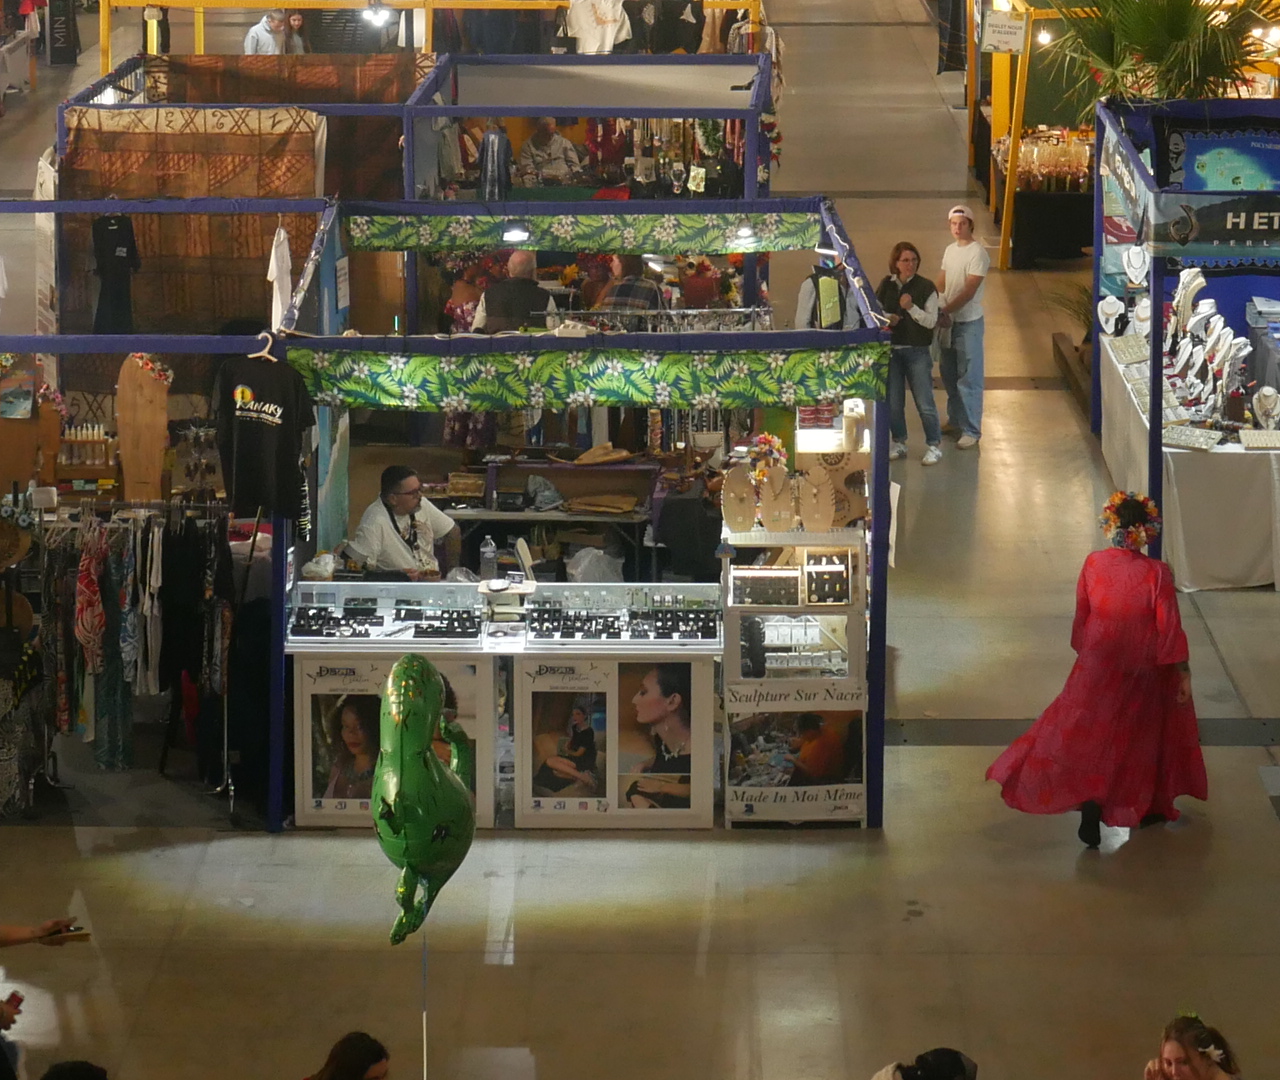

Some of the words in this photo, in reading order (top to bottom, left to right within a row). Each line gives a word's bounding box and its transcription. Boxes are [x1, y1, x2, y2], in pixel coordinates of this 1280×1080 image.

[1226, 212, 1245, 230] H
[236, 399, 284, 418] KANAKY
[729, 689, 790, 707] Sculpture
[794, 689, 819, 701] Sur
[731, 790, 769, 802] Made
[773, 791, 787, 803] In
[792, 790, 819, 802] Moi
[823, 787, 863, 800] Même
